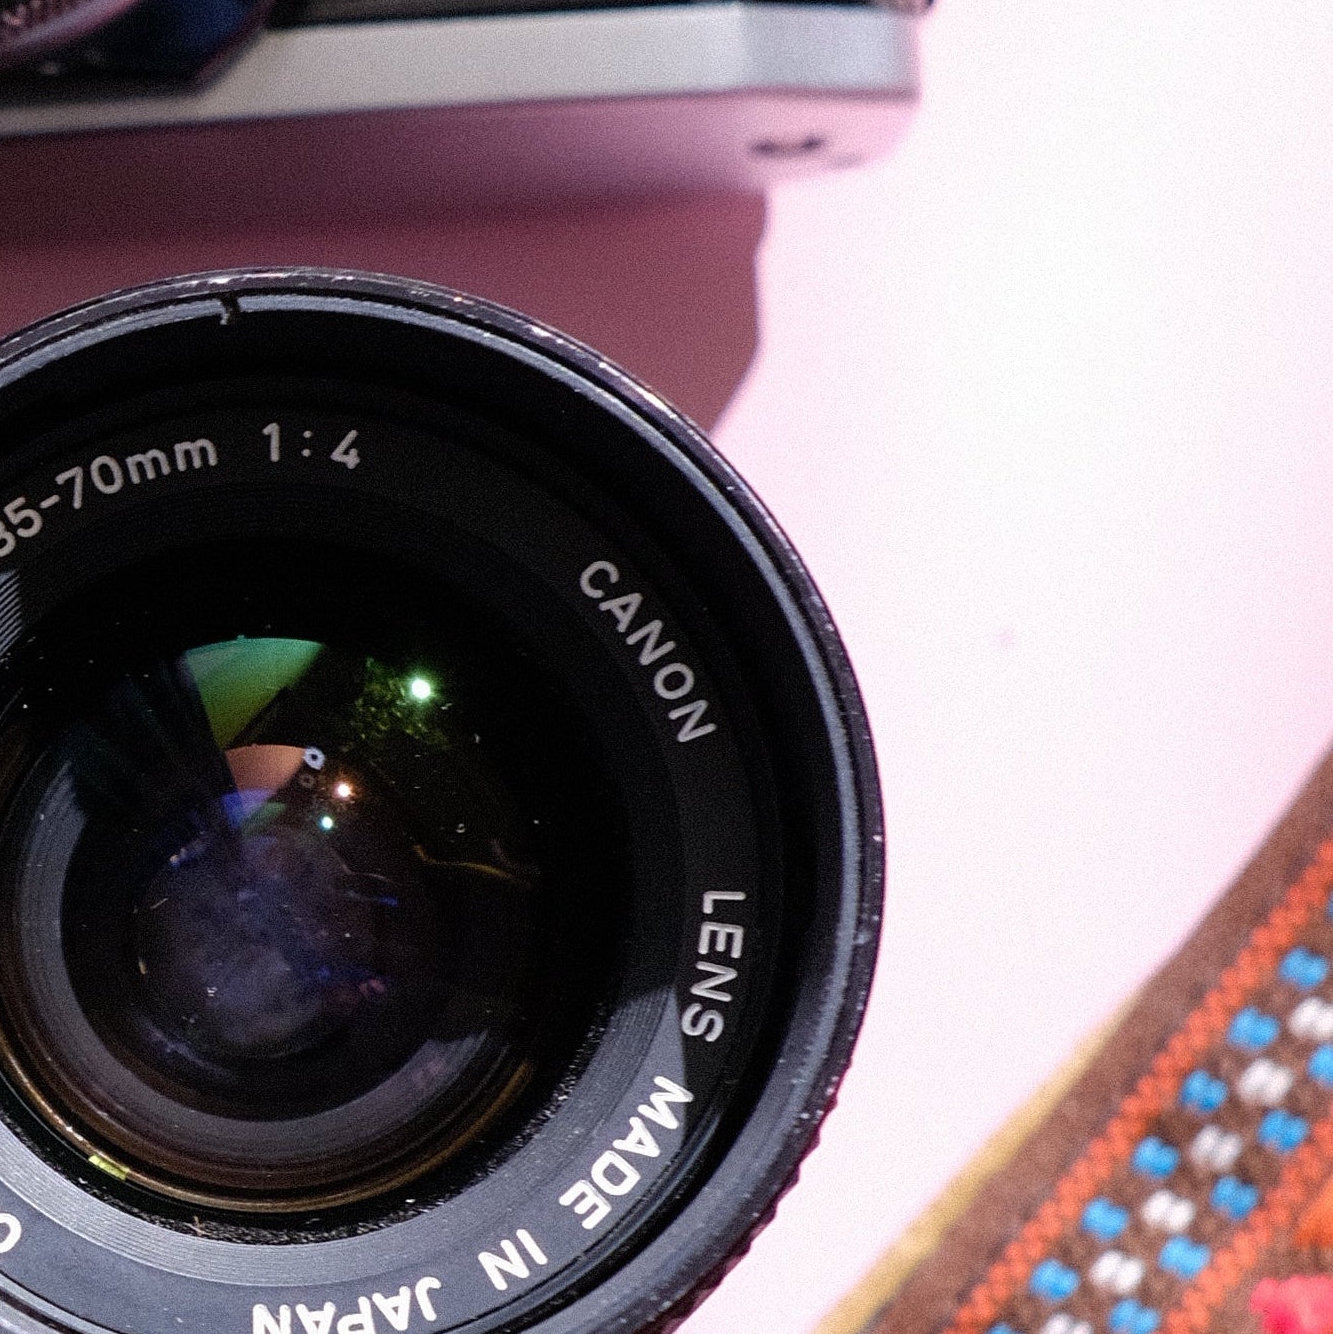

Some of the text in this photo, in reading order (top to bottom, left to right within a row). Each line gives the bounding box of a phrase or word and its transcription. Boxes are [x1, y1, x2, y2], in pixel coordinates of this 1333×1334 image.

[578, 559, 718, 744] CANON
[681, 890, 748, 1046] LENS
[560, 1075, 695, 1231] MADE
[478, 1229, 547, 1294] IN
